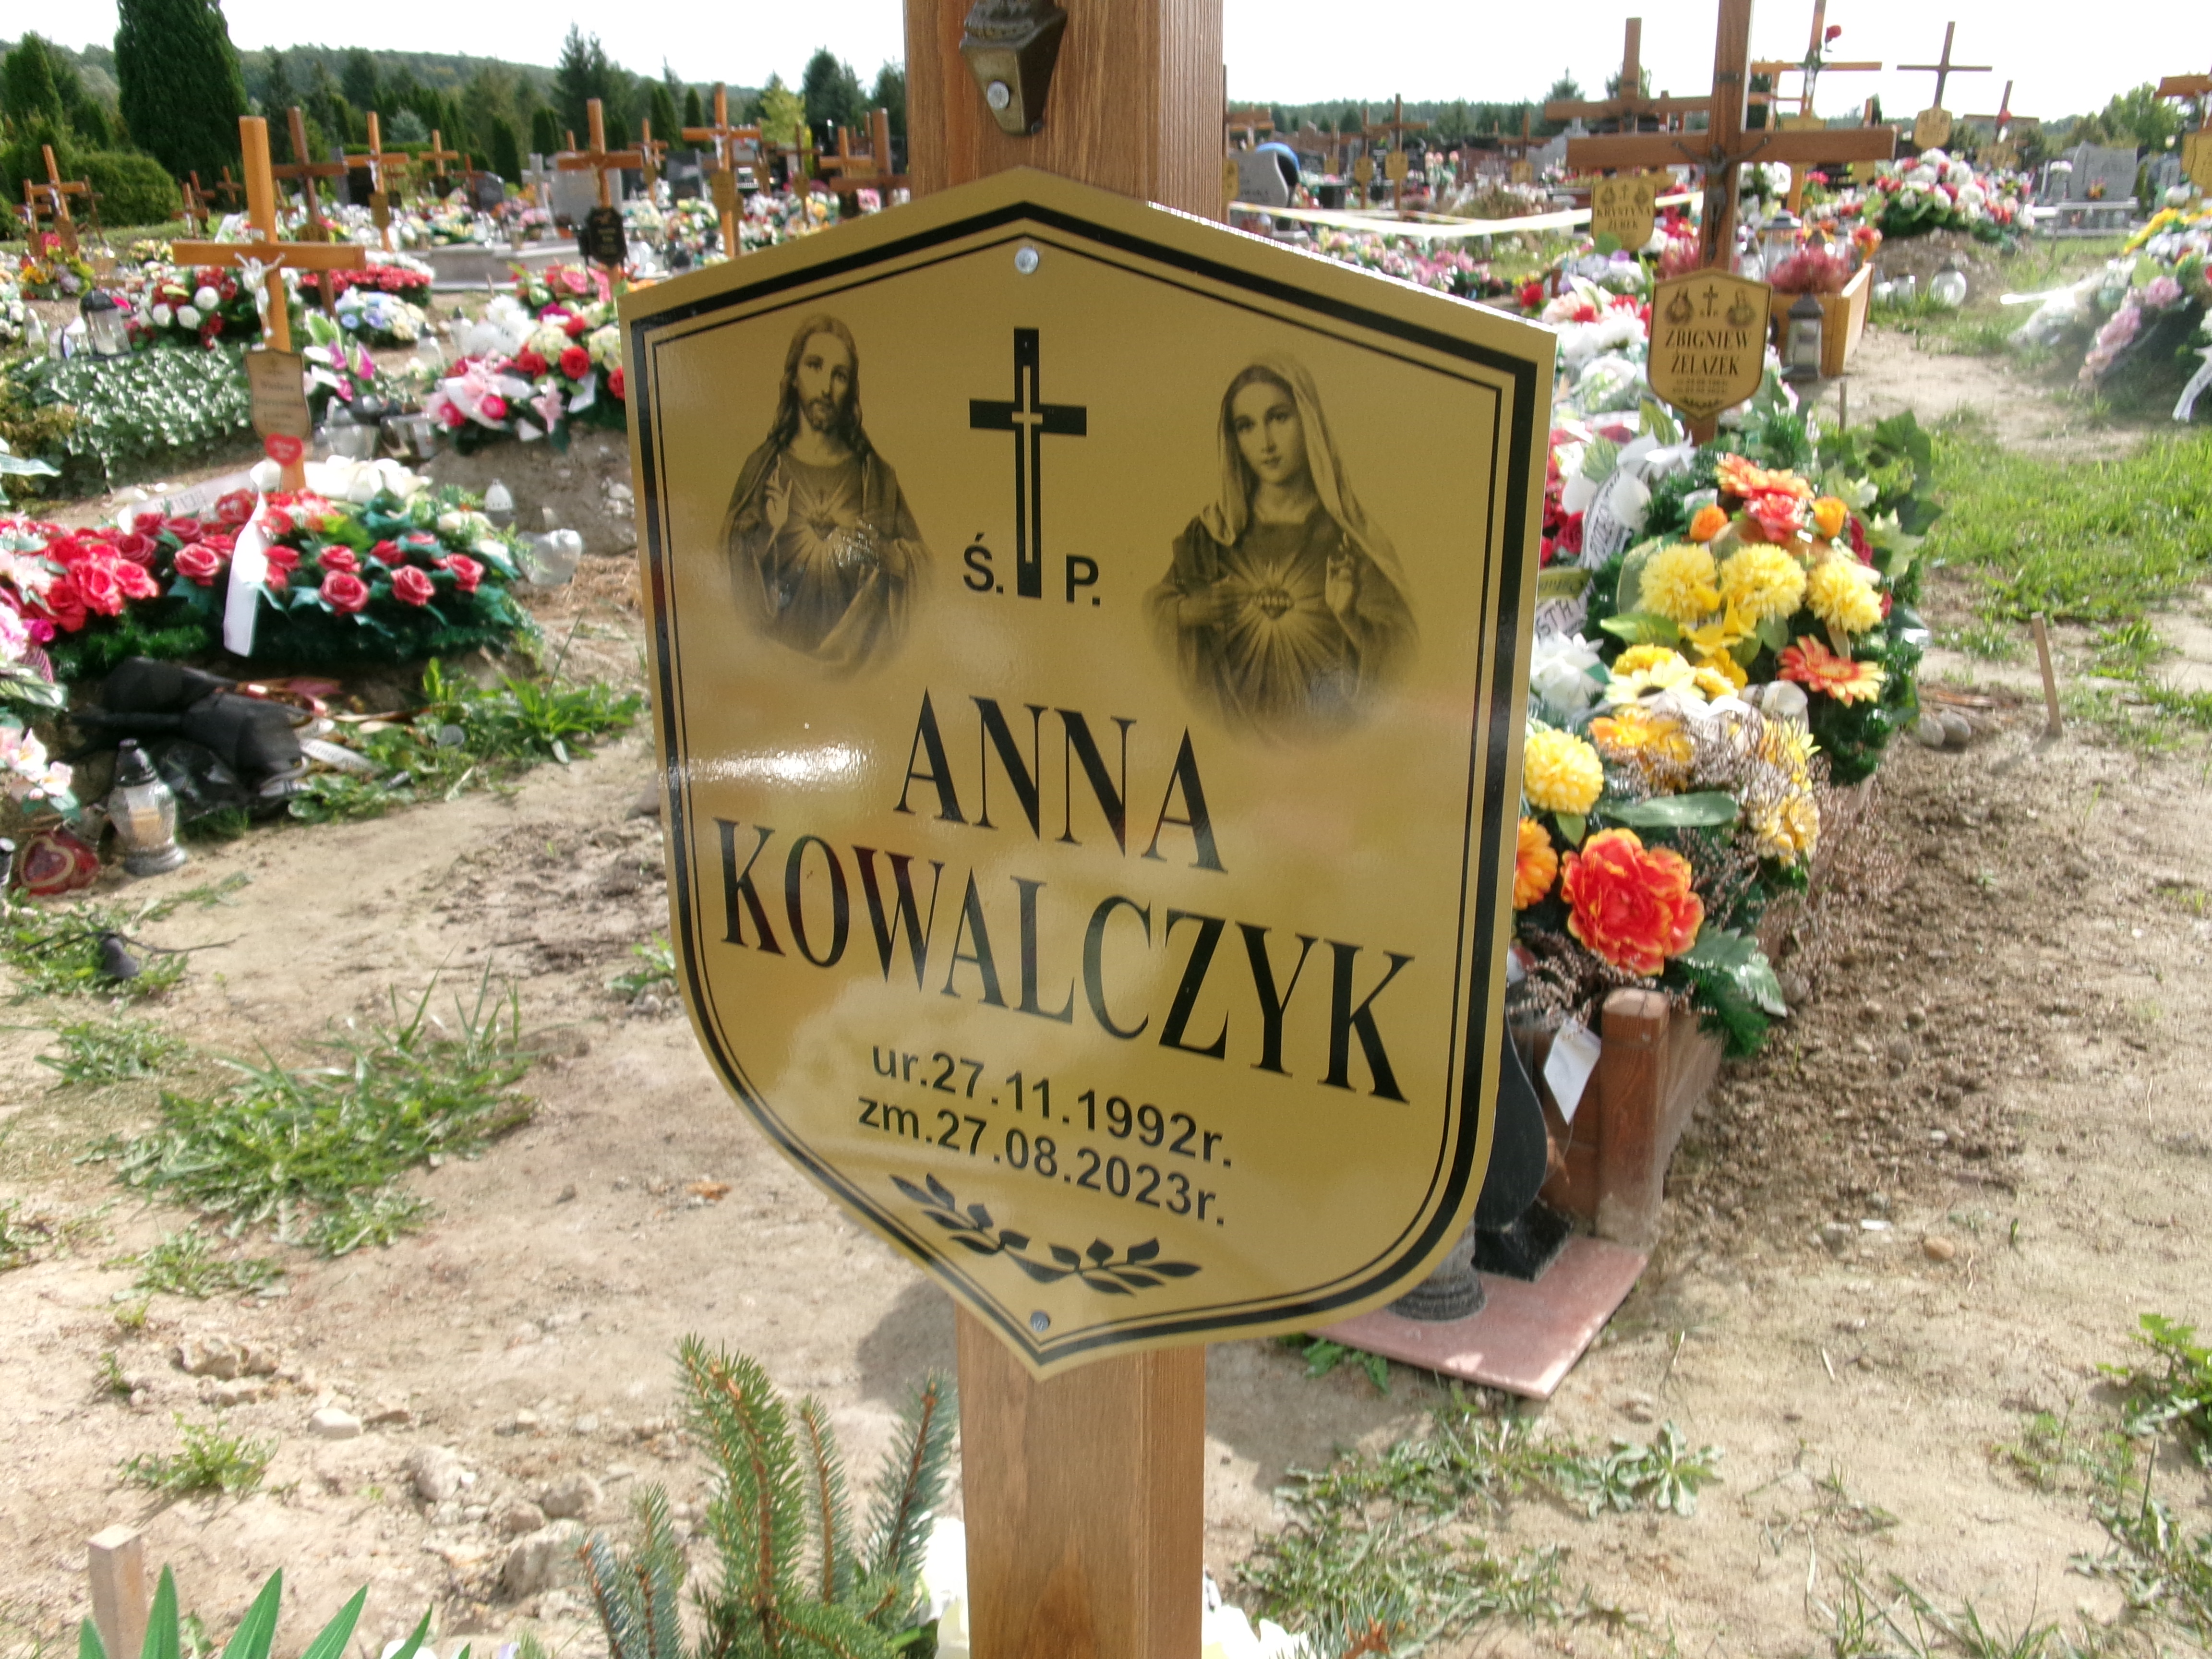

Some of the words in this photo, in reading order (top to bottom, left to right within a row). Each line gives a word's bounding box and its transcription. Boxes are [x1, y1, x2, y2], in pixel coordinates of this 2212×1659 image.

[1665, 330, 1752, 349] ZBIGNIEW
[963, 532, 1004, 594] Ś.
[1066, 553, 1100, 606] P.
[893, 686, 1228, 874] ANNA
[711, 817, 1415, 1106] KOWALCZYK
[858, 1096, 1225, 1226] zm.27.08.2023r.
[873, 1046, 1231, 1168] ur.27.11.1992r.
